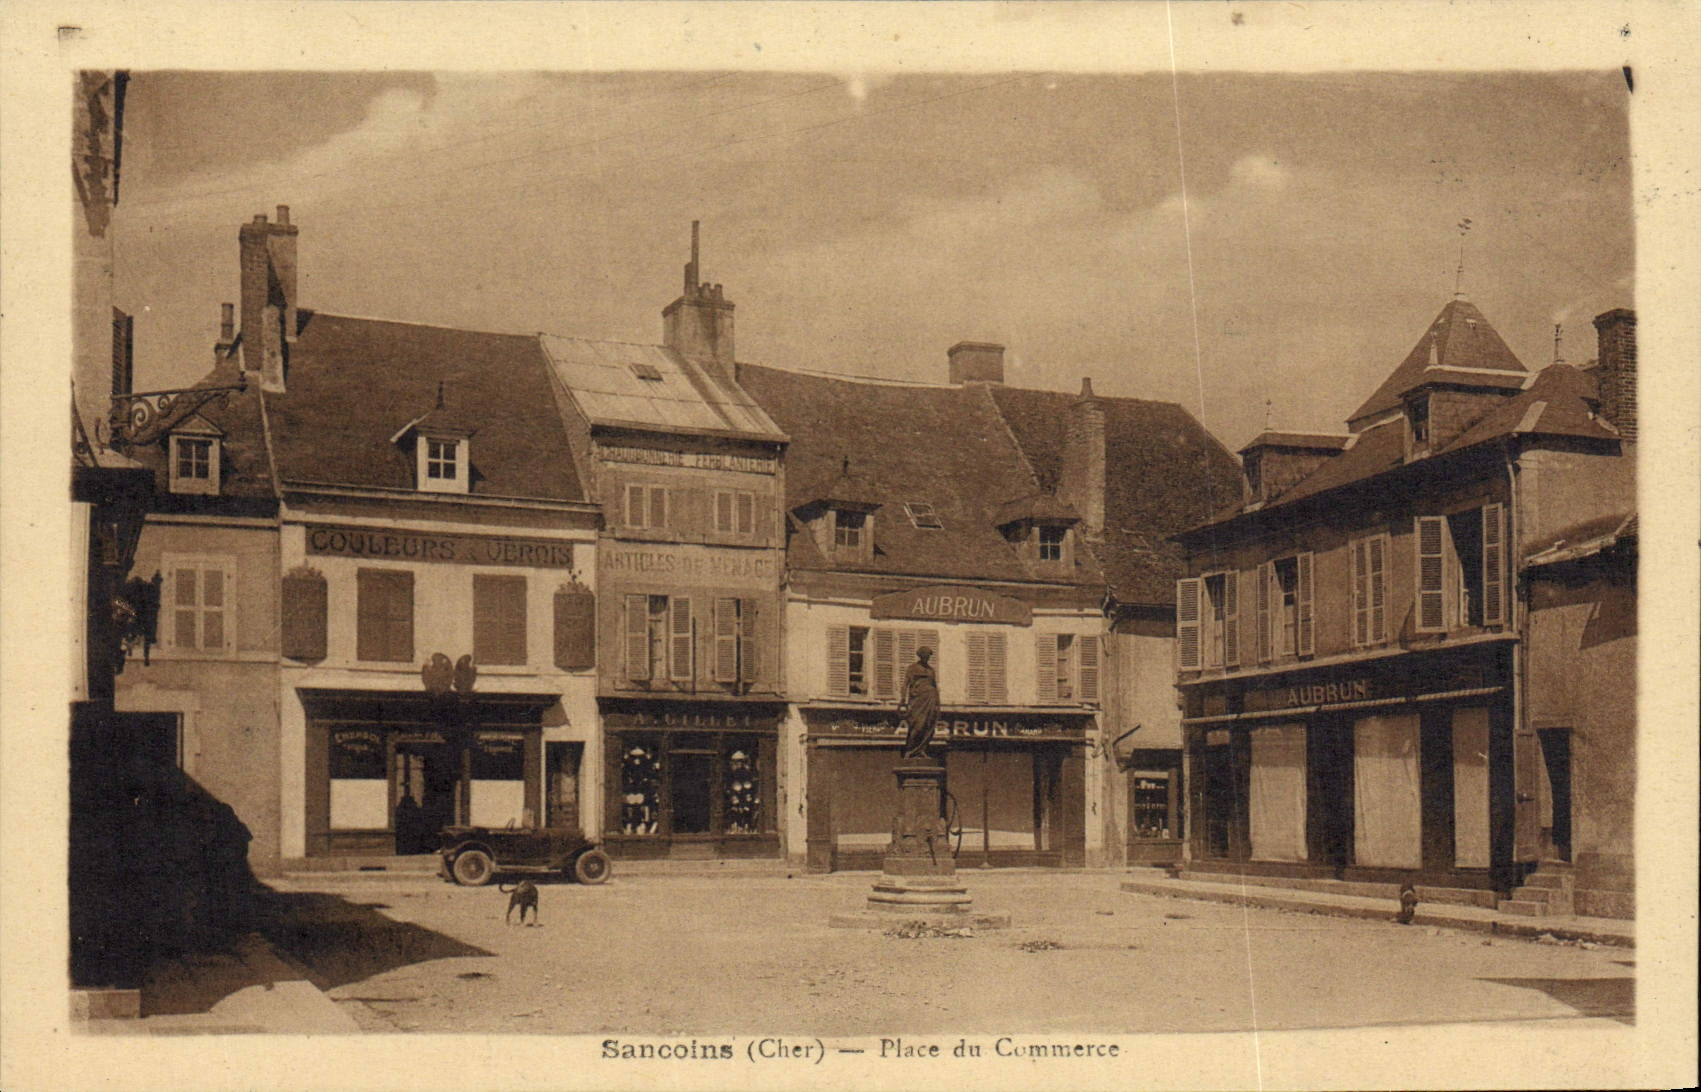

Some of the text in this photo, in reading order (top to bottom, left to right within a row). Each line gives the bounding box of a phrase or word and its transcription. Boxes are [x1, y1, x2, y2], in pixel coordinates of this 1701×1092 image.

[310, 531, 456, 560] COULEURS
[604, 552, 675, 573] ARTICLES
[683, 557, 705, 575] DE
[911, 596, 995, 618] AUBRUN
[1287, 680, 1367, 706] AUBRUN
[895, 720, 1008, 737] ABRUN
